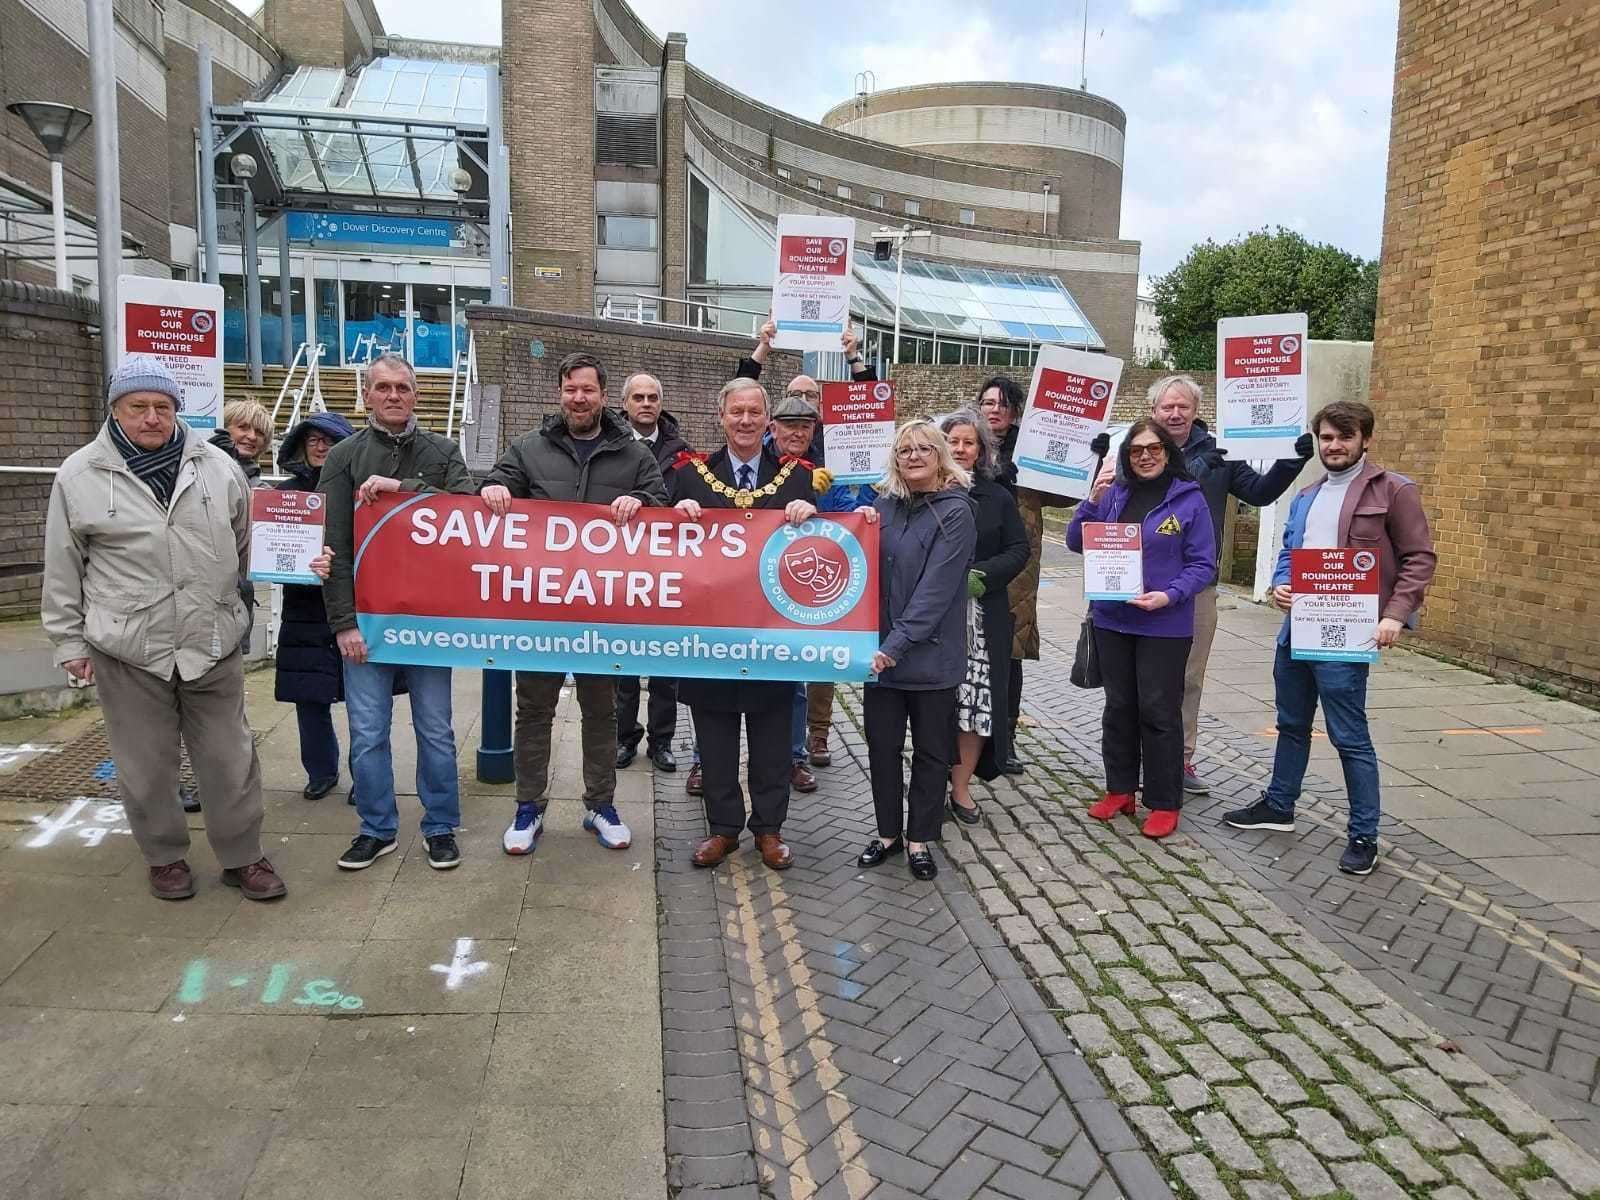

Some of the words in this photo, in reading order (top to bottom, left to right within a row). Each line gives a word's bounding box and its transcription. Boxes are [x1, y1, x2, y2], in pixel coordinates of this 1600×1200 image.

[343, 222, 369, 232] Dover
[372, 224, 414, 236] Discovery
[417, 226, 447, 237] Centre
[789, 255, 838, 264] ROUNDHOUSE
[160, 308, 183, 318] SAVE
[161, 320, 182, 330] OUR
[138, 330, 205, 342] ROUNDHOUSE
[151, 342, 192, 352] THEATRE
[1234, 356, 1291, 365] ROUNDHOUSE
[1067, 375, 1086, 386] SAVE
[1066, 386, 1082, 394] OUR
[1045, 390, 1098, 408] ROUNDHOUSE
[832, 402, 885, 411] ROUNDHOUSE
[1053, 402, 1086, 414] THEATRE
[266, 507, 311, 515] ROUNDHOUSE
[410, 508, 530, 550] SAVE
[783, 521, 851, 542] SORT
[472, 564, 684, 608] THEATRE
[767, 558, 776, 584] Save
[772, 586, 787, 605] Our
[787, 599, 850, 620] Roundhouse
[846, 556, 860, 598] Theatre
[384, 628, 850, 670] saveourroundhousetheatre.org
